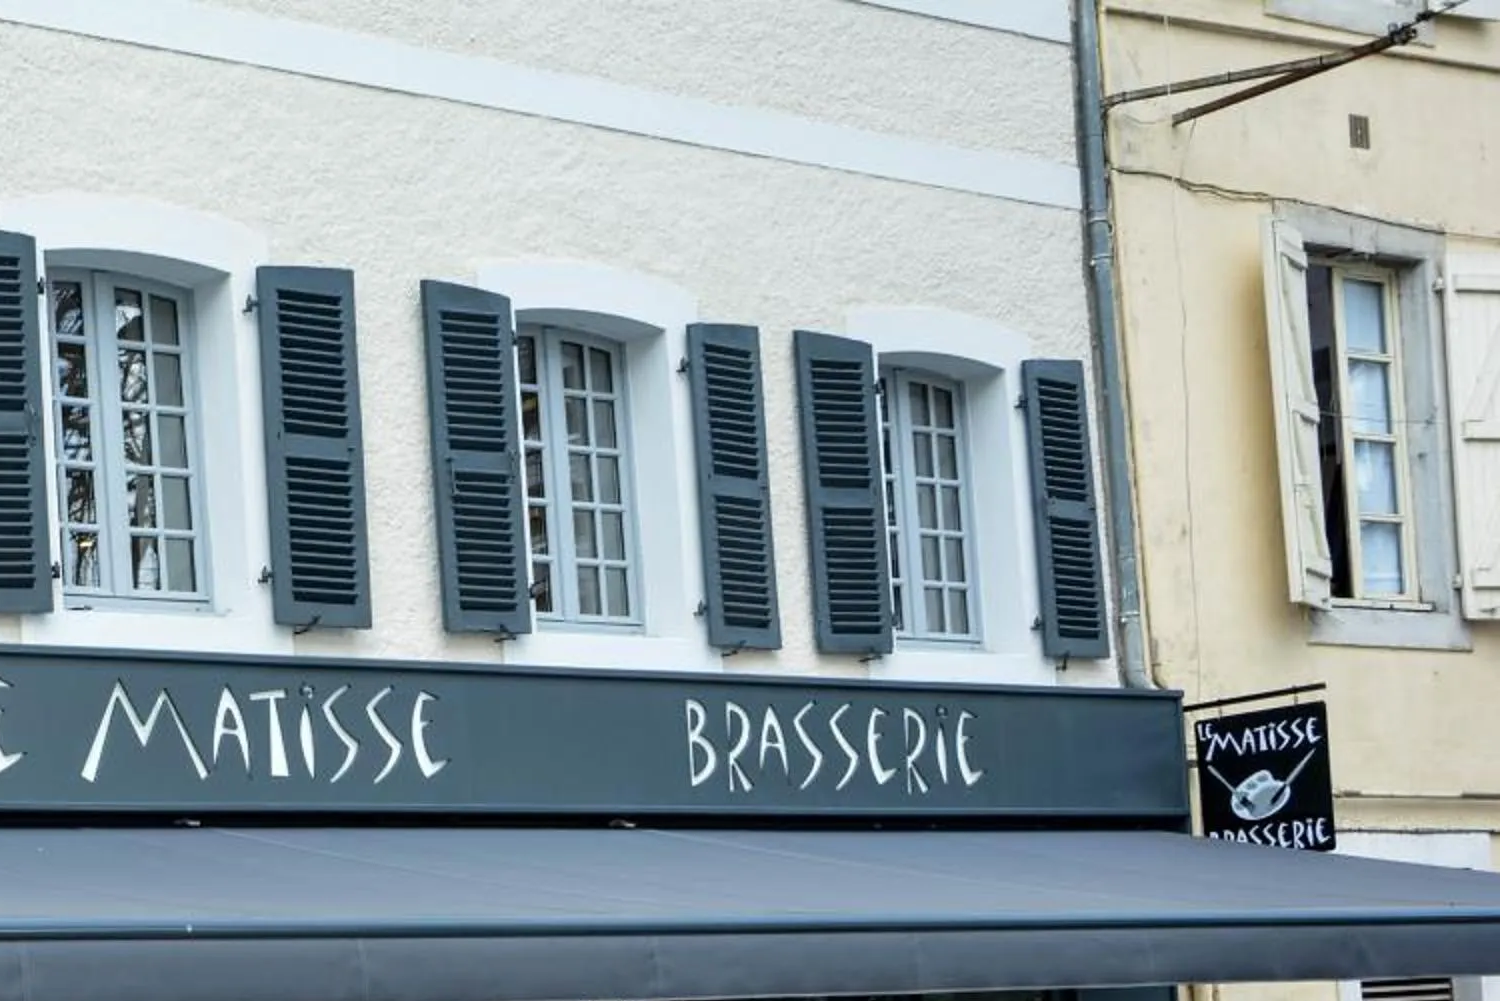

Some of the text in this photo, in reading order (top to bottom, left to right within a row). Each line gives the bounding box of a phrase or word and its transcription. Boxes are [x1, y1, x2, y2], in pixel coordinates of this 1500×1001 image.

[81, 678, 451, 783] MATISSE
[686, 699, 985, 795] BRASSERIE
[1197, 723, 1213, 741] LE
[1205, 716, 1322, 761] MATISSE
